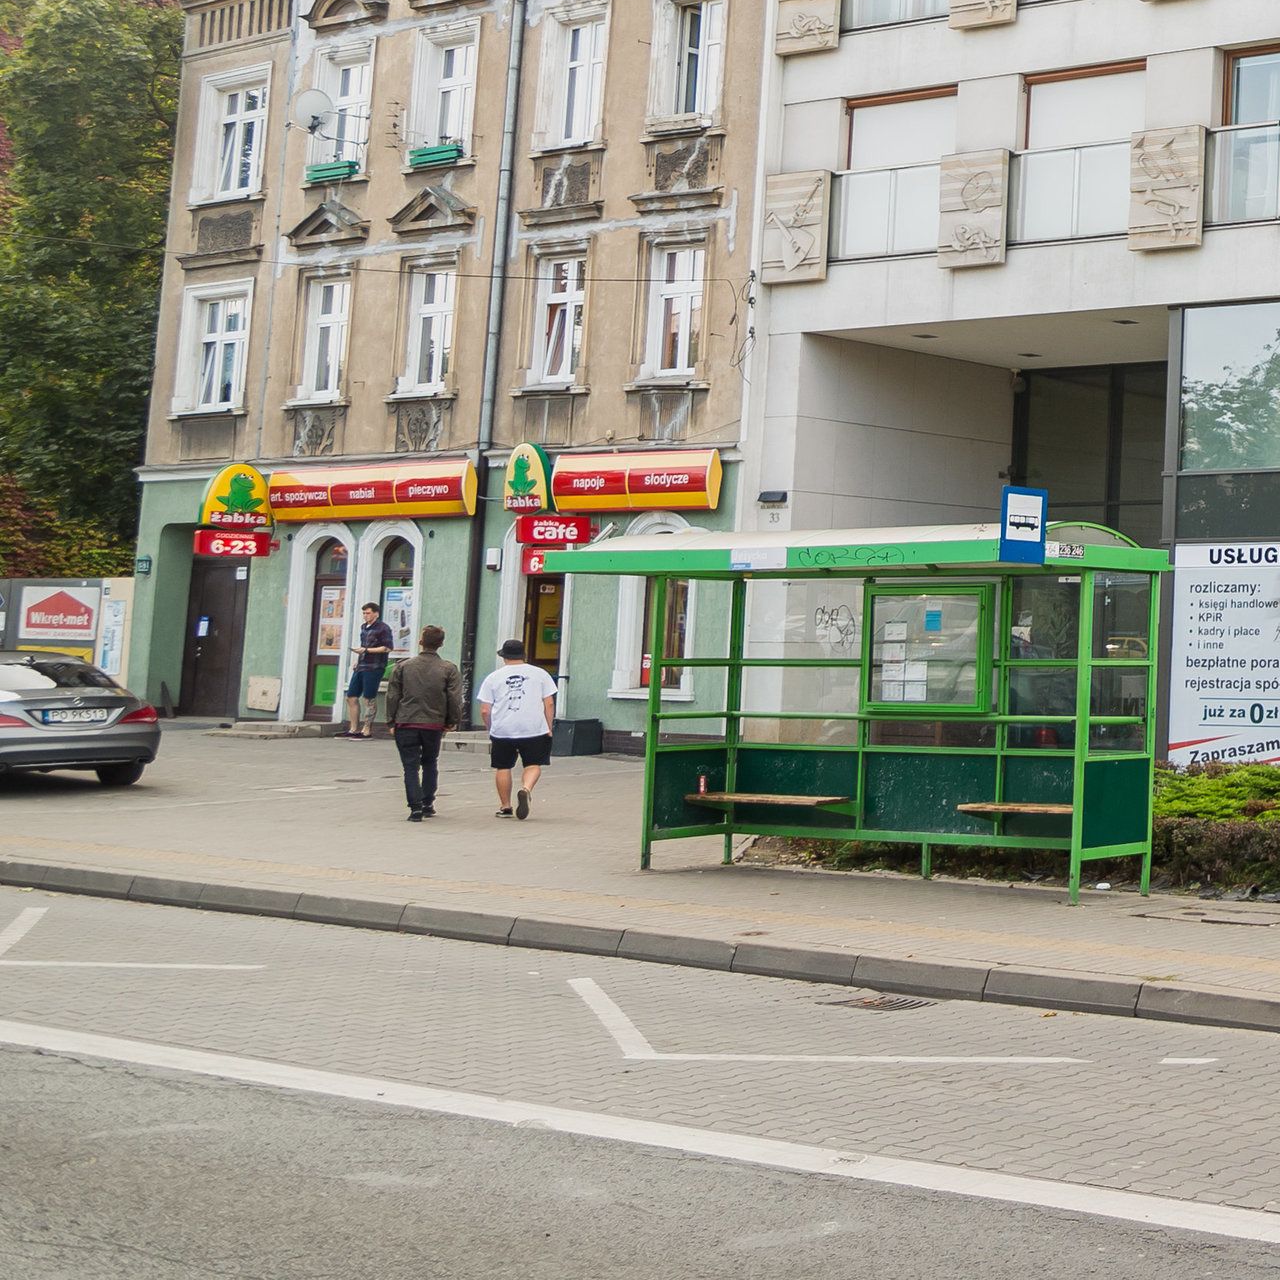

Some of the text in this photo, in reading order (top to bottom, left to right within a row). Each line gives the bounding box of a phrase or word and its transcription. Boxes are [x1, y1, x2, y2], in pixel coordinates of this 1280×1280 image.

[573, 477, 605, 490] napoje
[644, 473, 689, 488] słodycze
[270, 488, 327, 503] art. spożywcze
[349, 487, 375, 499] nabiał
[408, 483, 449, 498] pieczywo
[506, 495, 541, 508] żabka
[210, 512, 267, 524] żabka
[769, 512, 781, 523] 33
[533, 523, 578, 540] café
[211, 539, 257, 555] 6-23
[530, 557, 544, 572] 6-
[1190, 582, 1261, 596] rozliczamy:
[1199, 599, 1279, 611] księgi handlowe
[30, 611, 89, 627] Wkręt-met
[1198, 613, 1222, 622] KPiR
[1198, 627, 1225, 637] kadry
[1234, 627, 1260, 637] płace
[1203, 641, 1224, 649] inne
[1186, 656, 1246, 670] bezpłatne
[1185, 678, 1251, 691] rejestracja
[52, 710, 68, 720] PO
[1203, 703, 1278, 724] już za 0 zł
